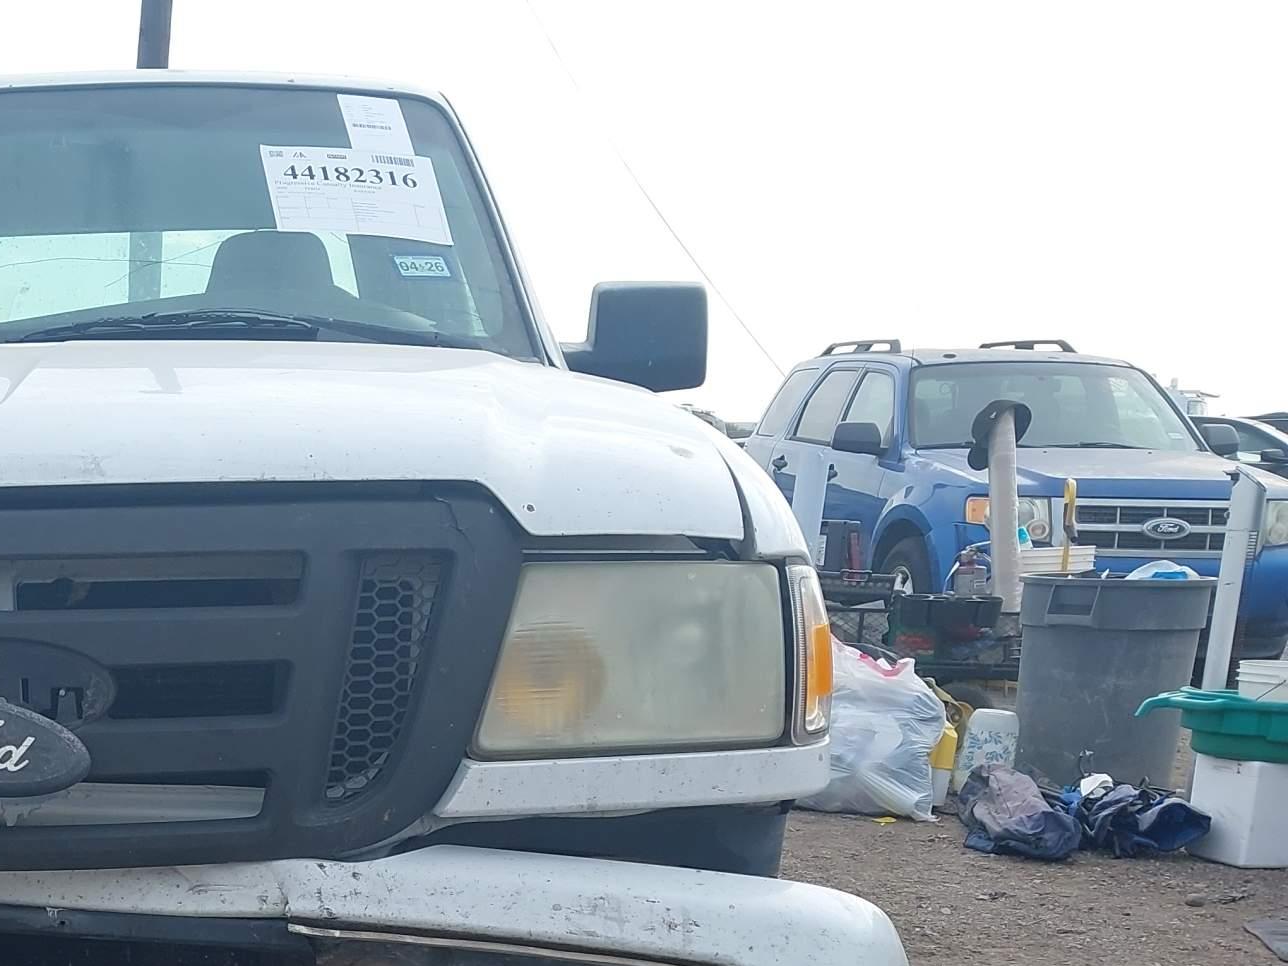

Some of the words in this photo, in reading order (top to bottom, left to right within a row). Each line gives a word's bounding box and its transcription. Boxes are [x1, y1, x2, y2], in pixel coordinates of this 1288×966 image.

[283, 164, 418, 188] 44182316
[399, 261, 419, 272] 04
[424, 261, 445, 272] 26
[1157, 523, 1180, 533] Ford
